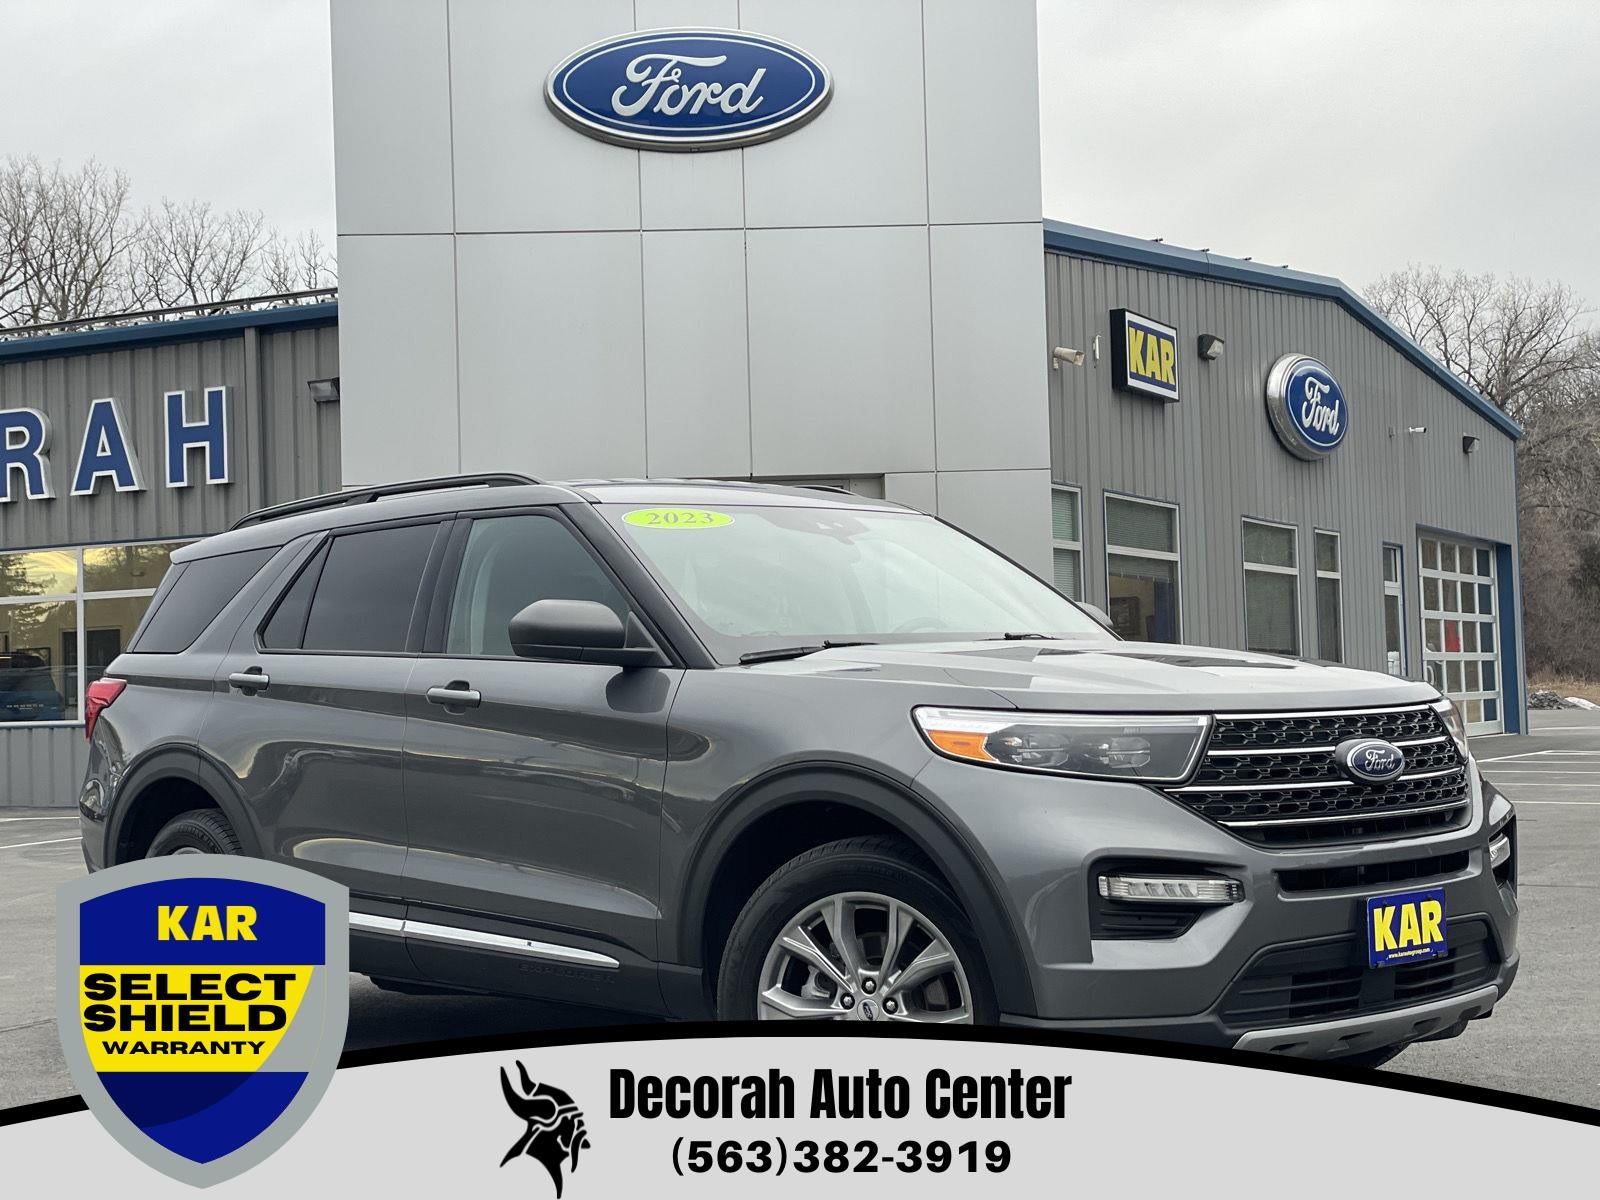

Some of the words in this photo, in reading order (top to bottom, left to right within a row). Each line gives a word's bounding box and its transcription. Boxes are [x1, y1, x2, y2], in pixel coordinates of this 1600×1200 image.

[611, 53, 767, 117] Ford
[1128, 326, 1176, 385] KAR
[1301, 376, 1340, 436] Ford
[646, 512, 714, 525] 2023
[1365, 749, 1396, 772] Ford
[1373, 899, 1444, 952] KAR
